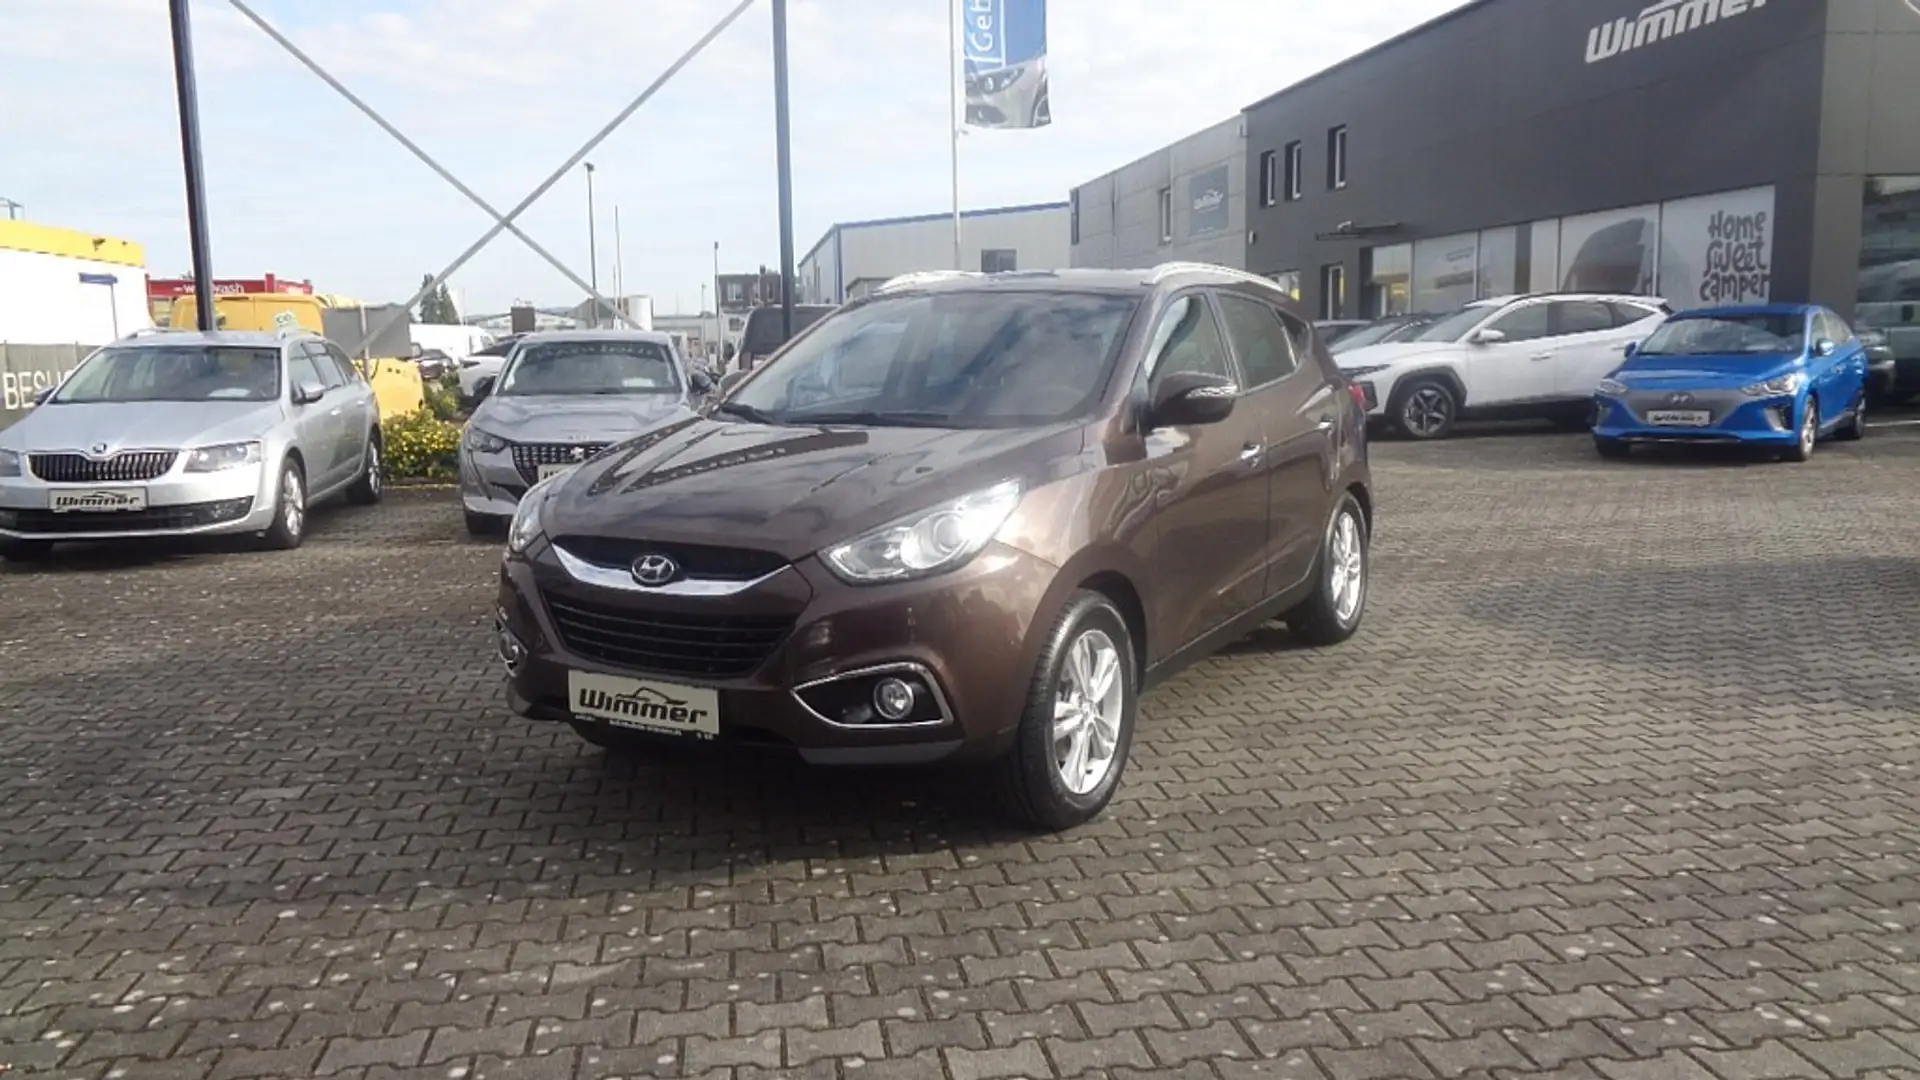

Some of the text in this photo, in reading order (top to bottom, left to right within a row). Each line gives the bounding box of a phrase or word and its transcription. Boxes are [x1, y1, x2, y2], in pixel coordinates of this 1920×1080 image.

[1585, 0, 1767, 63] Wimme
[1708, 210, 1767, 241] Home
[1699, 272, 1772, 302] camper
[579, 687, 708, 723] Wimmer
